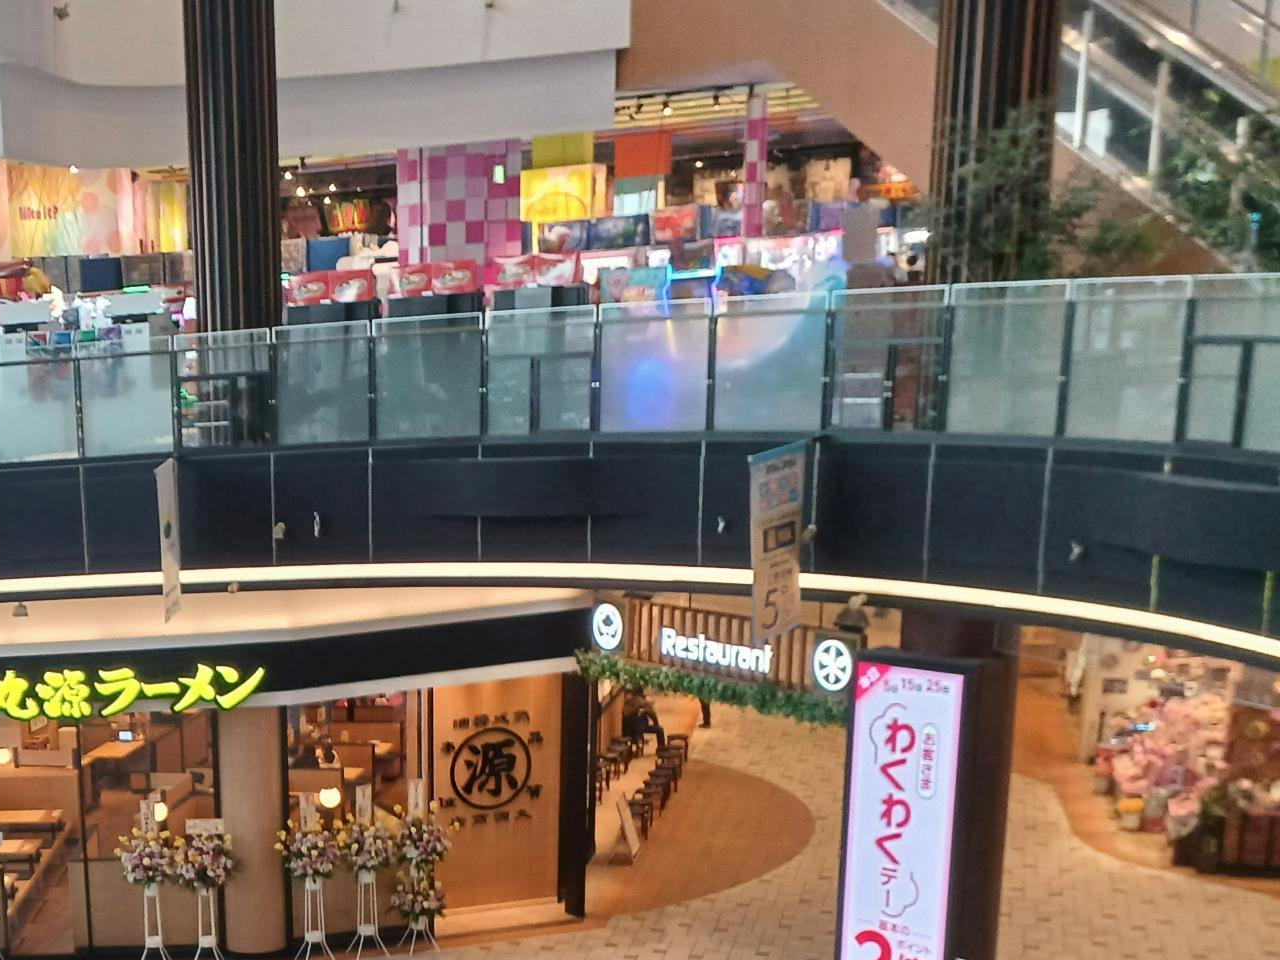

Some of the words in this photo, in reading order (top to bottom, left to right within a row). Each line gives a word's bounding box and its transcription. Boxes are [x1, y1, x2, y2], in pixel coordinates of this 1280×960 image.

[661, 627, 773, 674] Restaurant
[460, 737, 519, 798] 源
[875, 717, 916, 909] わくわくデー
